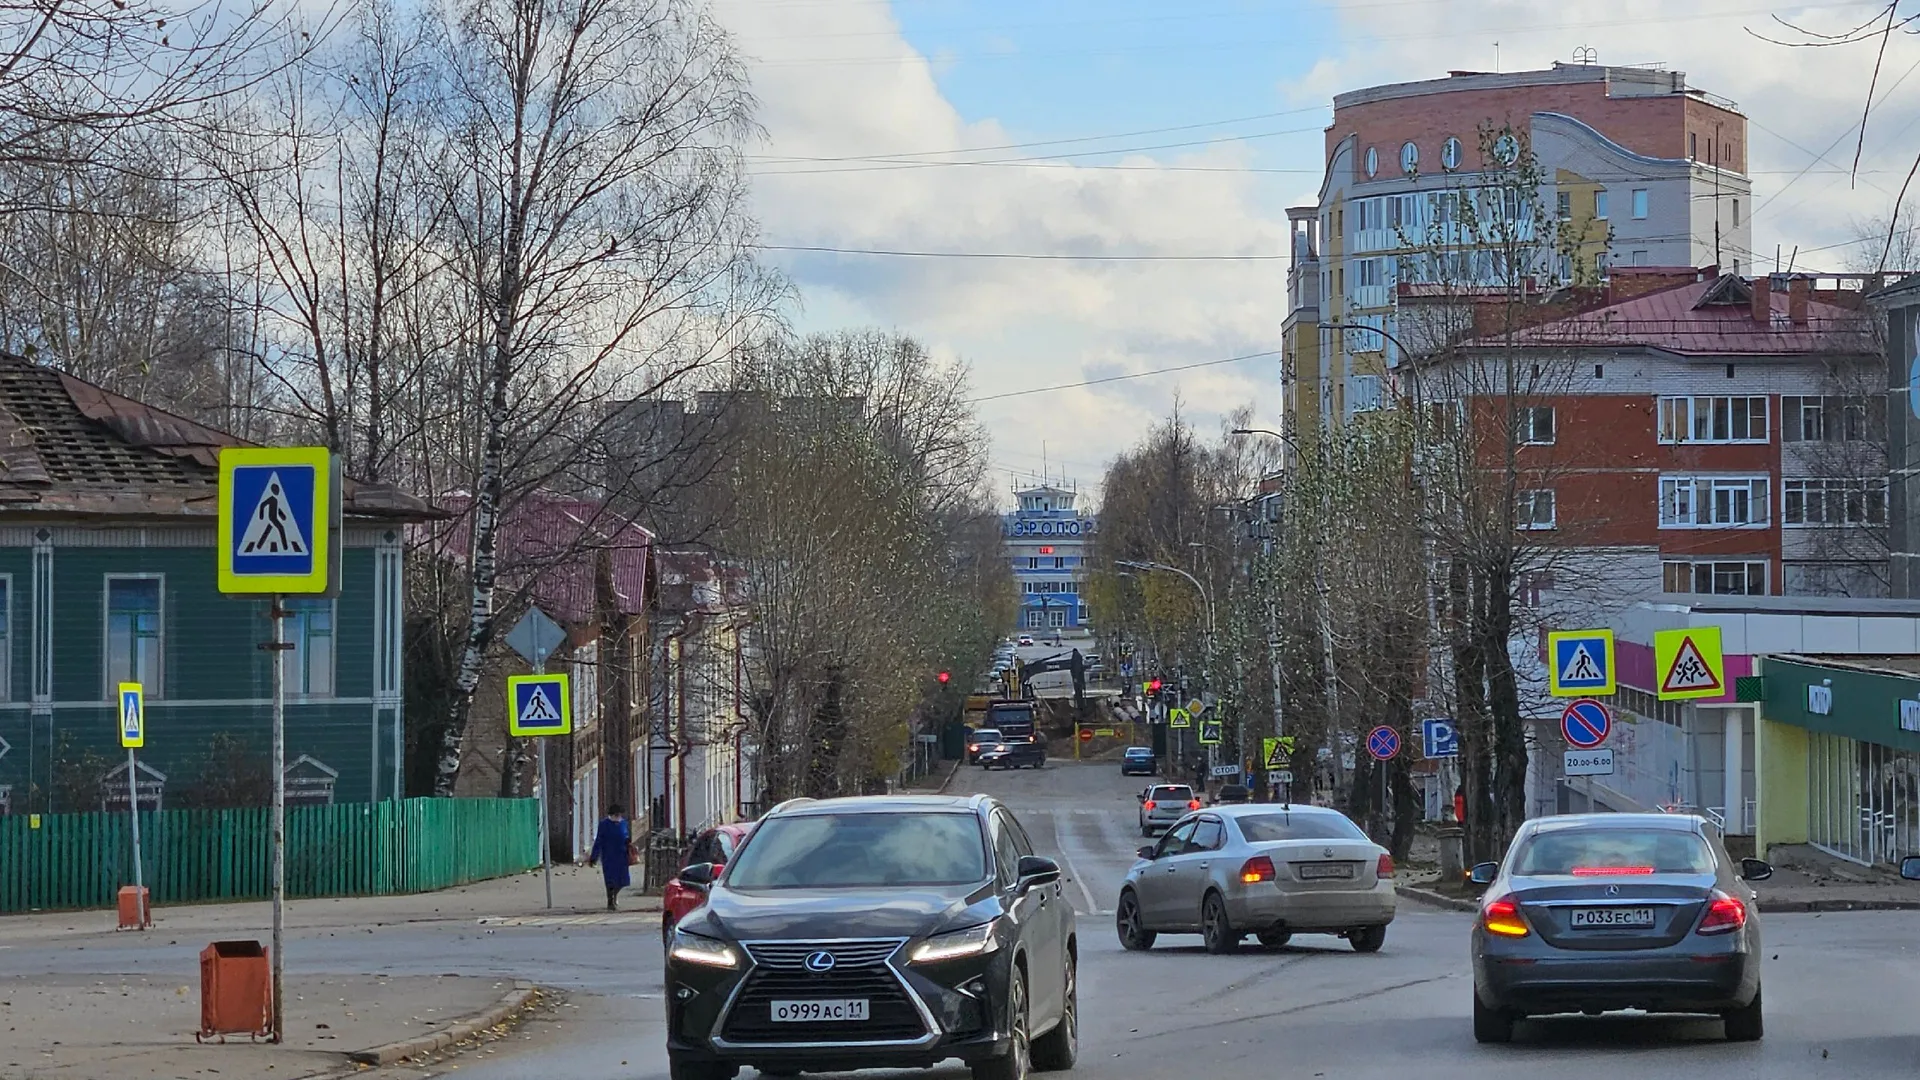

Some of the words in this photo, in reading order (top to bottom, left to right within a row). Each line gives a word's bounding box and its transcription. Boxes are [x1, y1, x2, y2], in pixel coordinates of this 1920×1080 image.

[1431, 723, 1453, 756] P
[1567, 757, 1611, 767] 20.00-6.00
[1215, 765, 1236, 774] СТОП
[848, 1001, 862, 1013] 11
